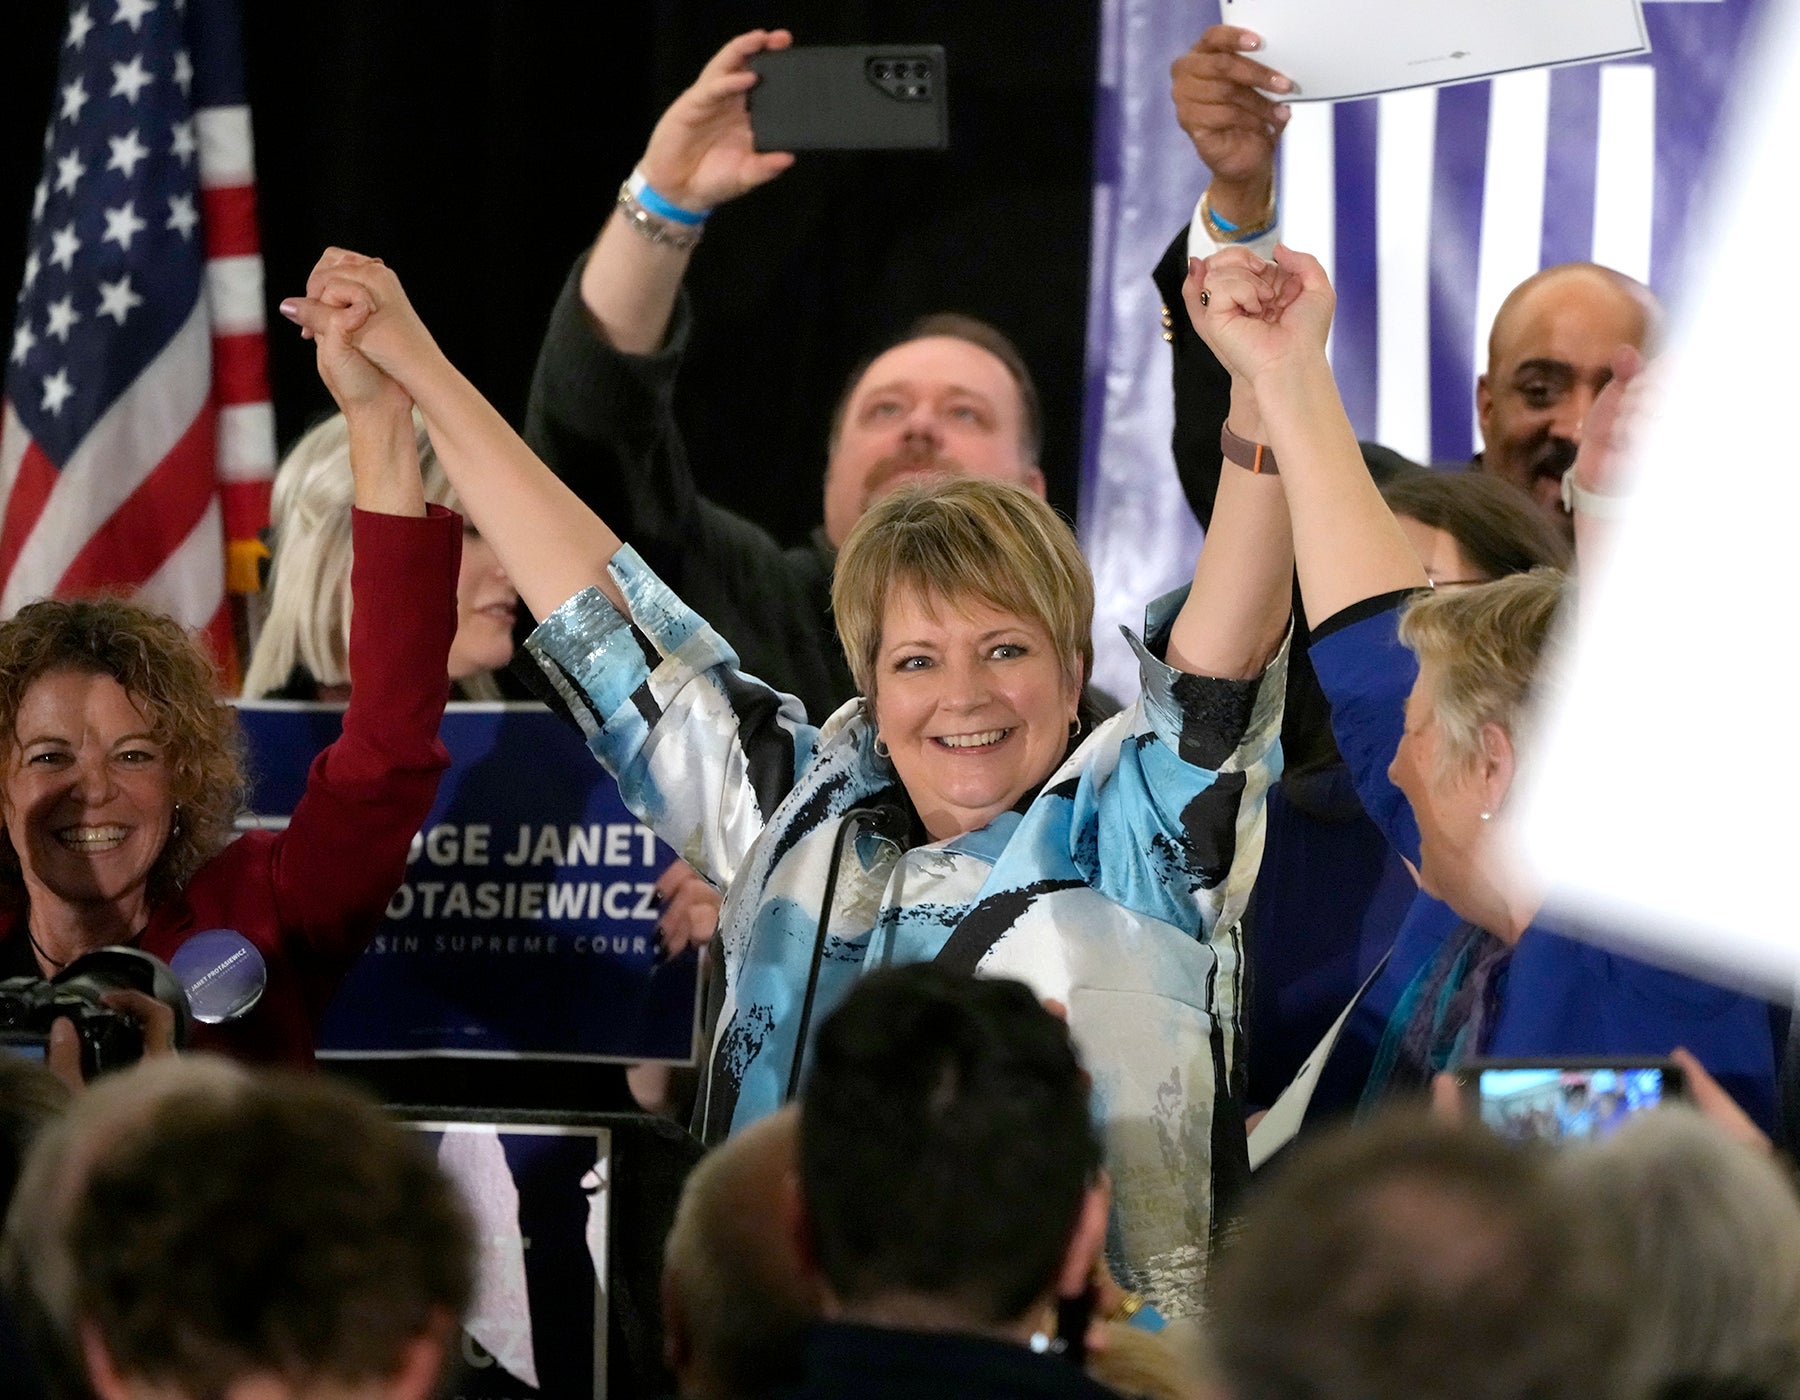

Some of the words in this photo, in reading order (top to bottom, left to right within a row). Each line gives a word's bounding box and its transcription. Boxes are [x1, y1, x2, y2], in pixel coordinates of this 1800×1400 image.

[503, 824, 656, 867] JANET
[385, 882, 659, 920] OTASIEWICZ
[365, 935, 419, 954] SIN
[435, 934, 559, 954] SUPREME
